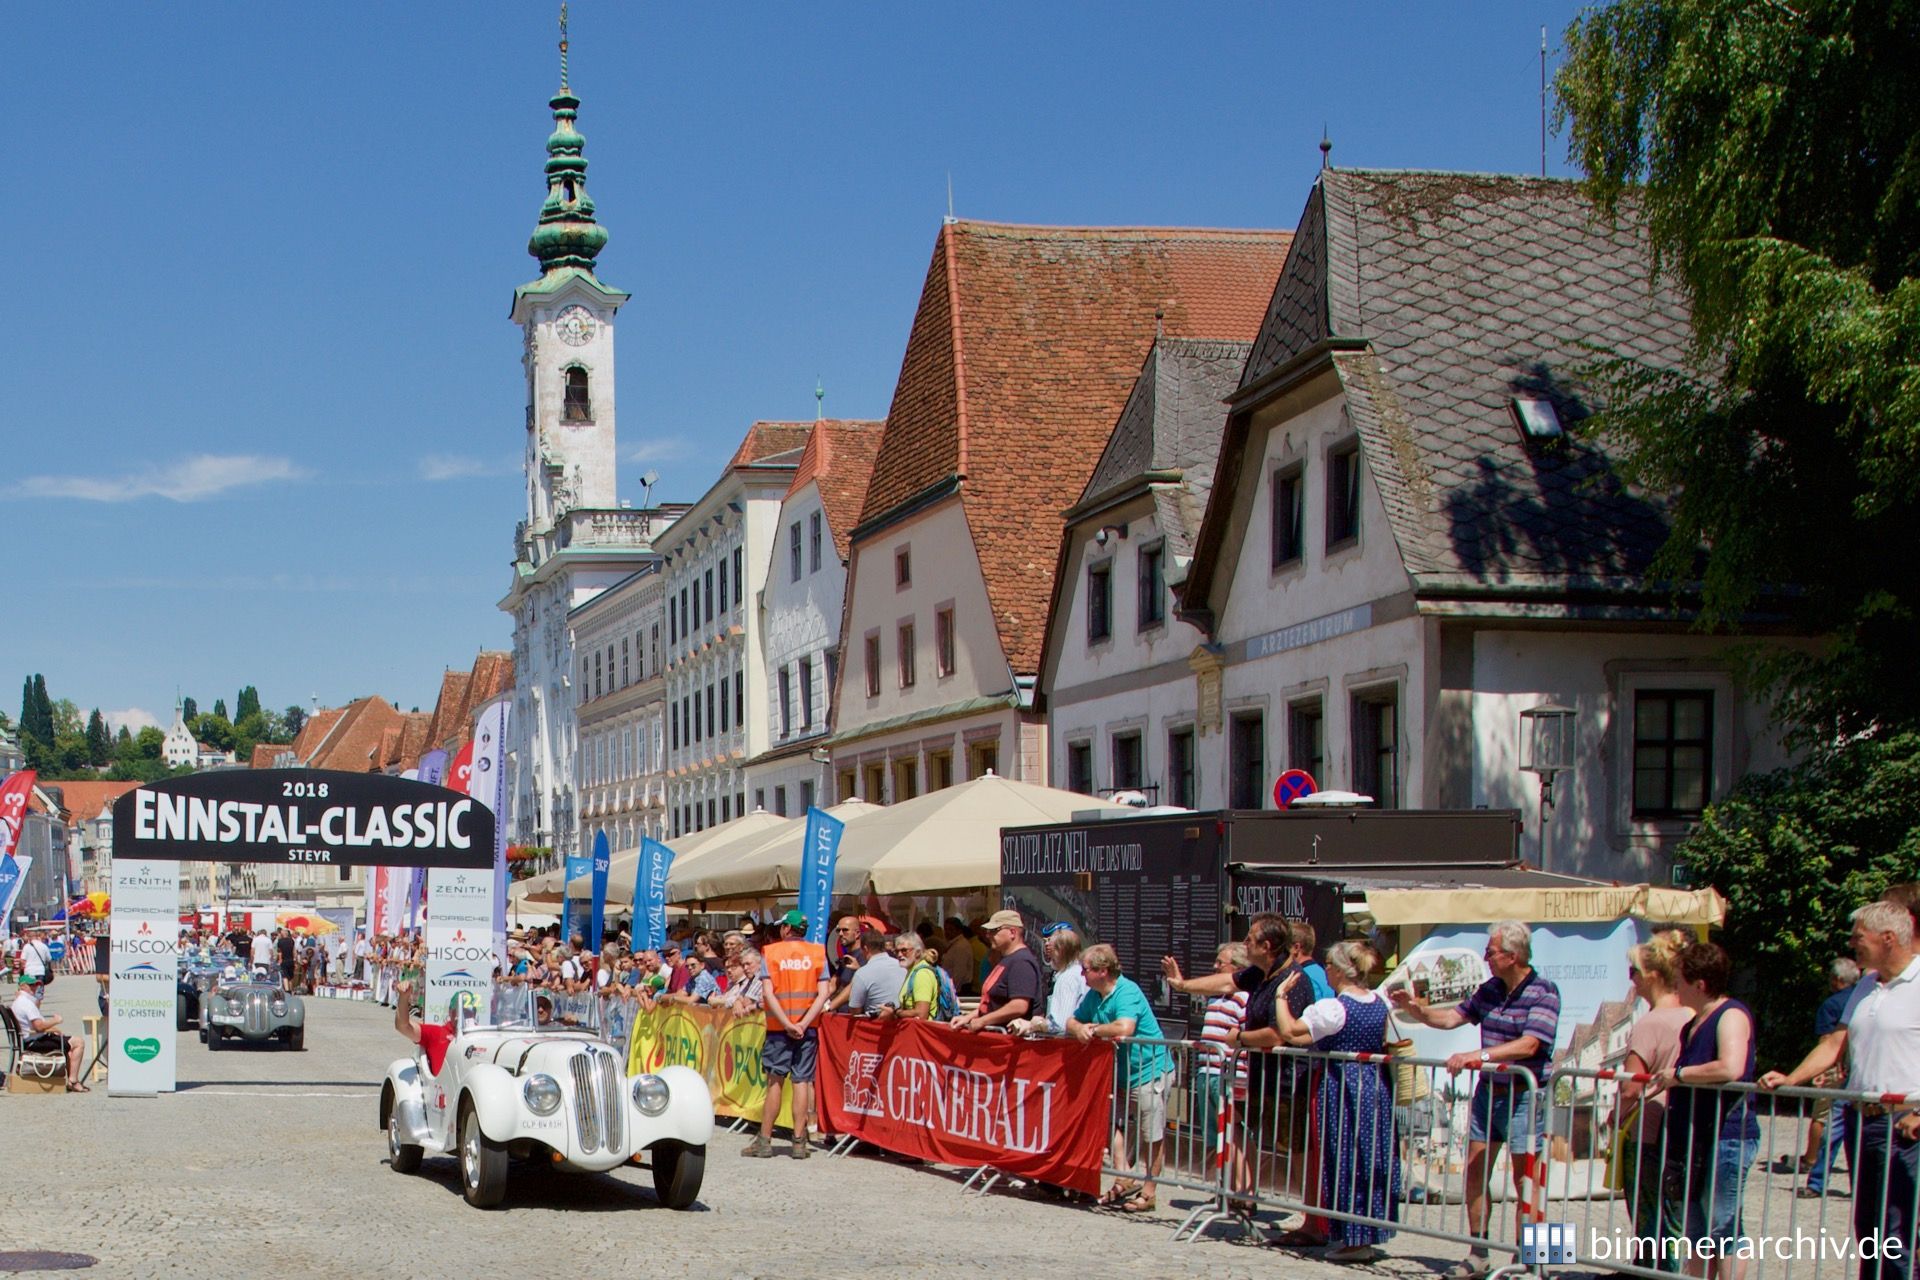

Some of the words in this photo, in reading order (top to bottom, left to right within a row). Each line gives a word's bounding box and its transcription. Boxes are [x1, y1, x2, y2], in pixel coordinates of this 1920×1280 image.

[282, 781, 329, 797] 2018
[135, 788, 472, 849] ENNSTAL-CLASSIC
[288, 849, 331, 862] STEYR
[1003, 833, 1062, 875] STADTPLATZ
[1106, 845, 1120, 871] DAS
[119, 877, 172, 886] ZENITH
[435, 885, 487, 894] ZENITH
[1237, 886, 1266, 915] SAGEN
[1267, 886, 1282, 913] SIE
[1544, 890, 1582, 918] FRAU
[111, 939, 178, 954] HISCOX
[427, 946, 491, 961] HISCOX
[780, 955, 812, 971] ARBÖ
[114, 972, 174, 981] VREDESTEIN
[1563, 964, 1608, 979] STADTPLATZ
[430, 979, 488, 988] VREDESTEIN
[114, 998, 173, 1008] SCHLADMING
[887, 1055, 1056, 1155] GENERALI
